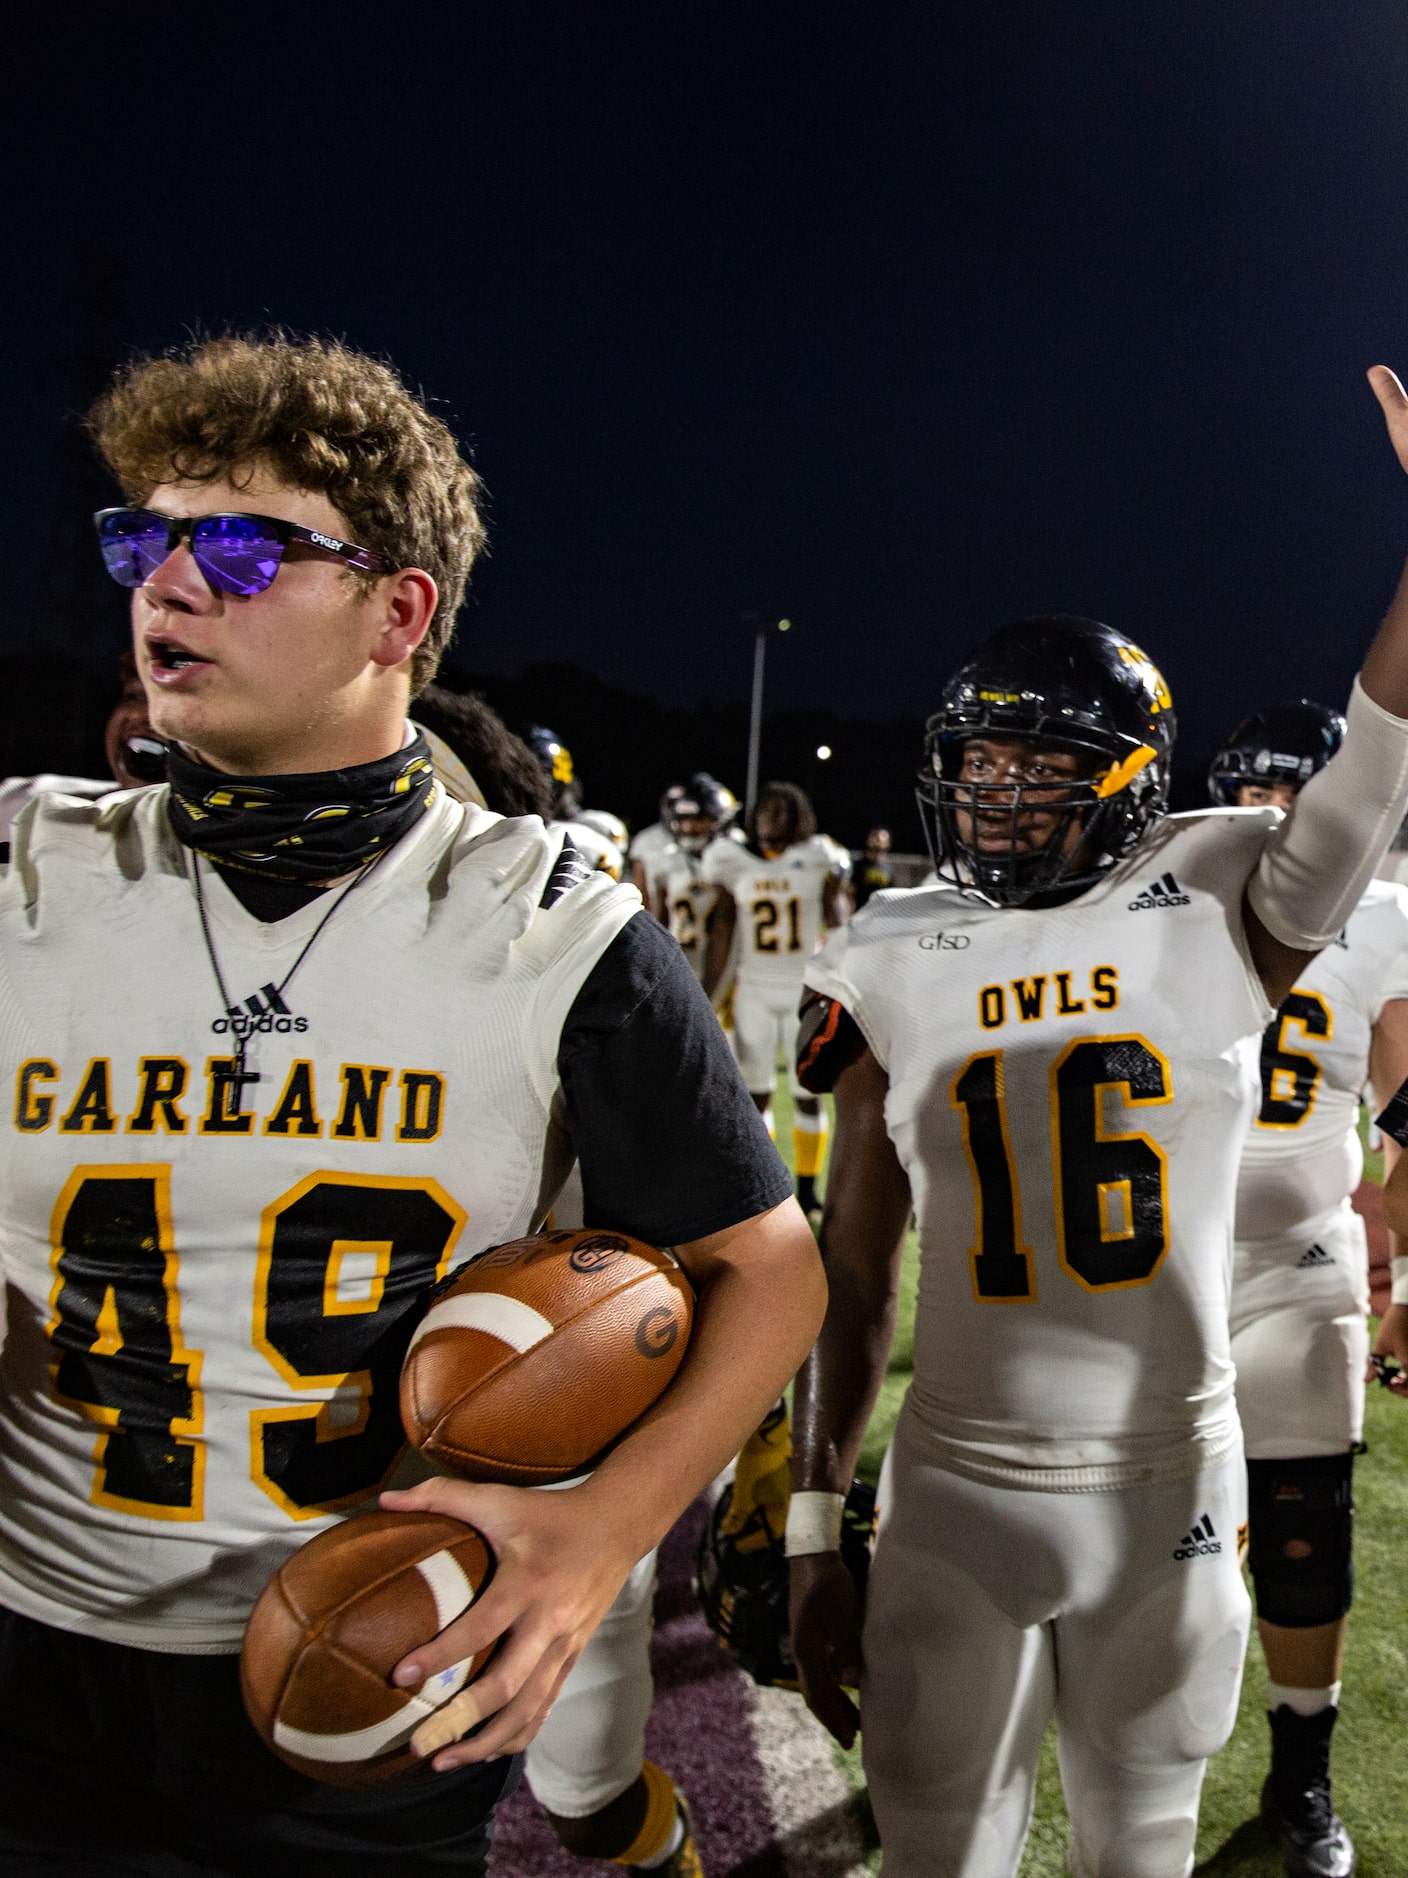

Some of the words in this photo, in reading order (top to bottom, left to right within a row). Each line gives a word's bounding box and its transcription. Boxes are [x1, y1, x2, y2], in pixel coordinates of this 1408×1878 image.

[752, 896, 802, 954] 21
[1128, 894, 1190, 911] adidas
[212, 1015, 309, 1034] adidas
[978, 966, 1120, 1030] OWLS
[14, 1055, 447, 1143] GARLAND
[949, 1033, 1175, 1304] 16
[46, 1163, 468, 1523] 49
[1173, 1538, 1222, 1561] adidas
